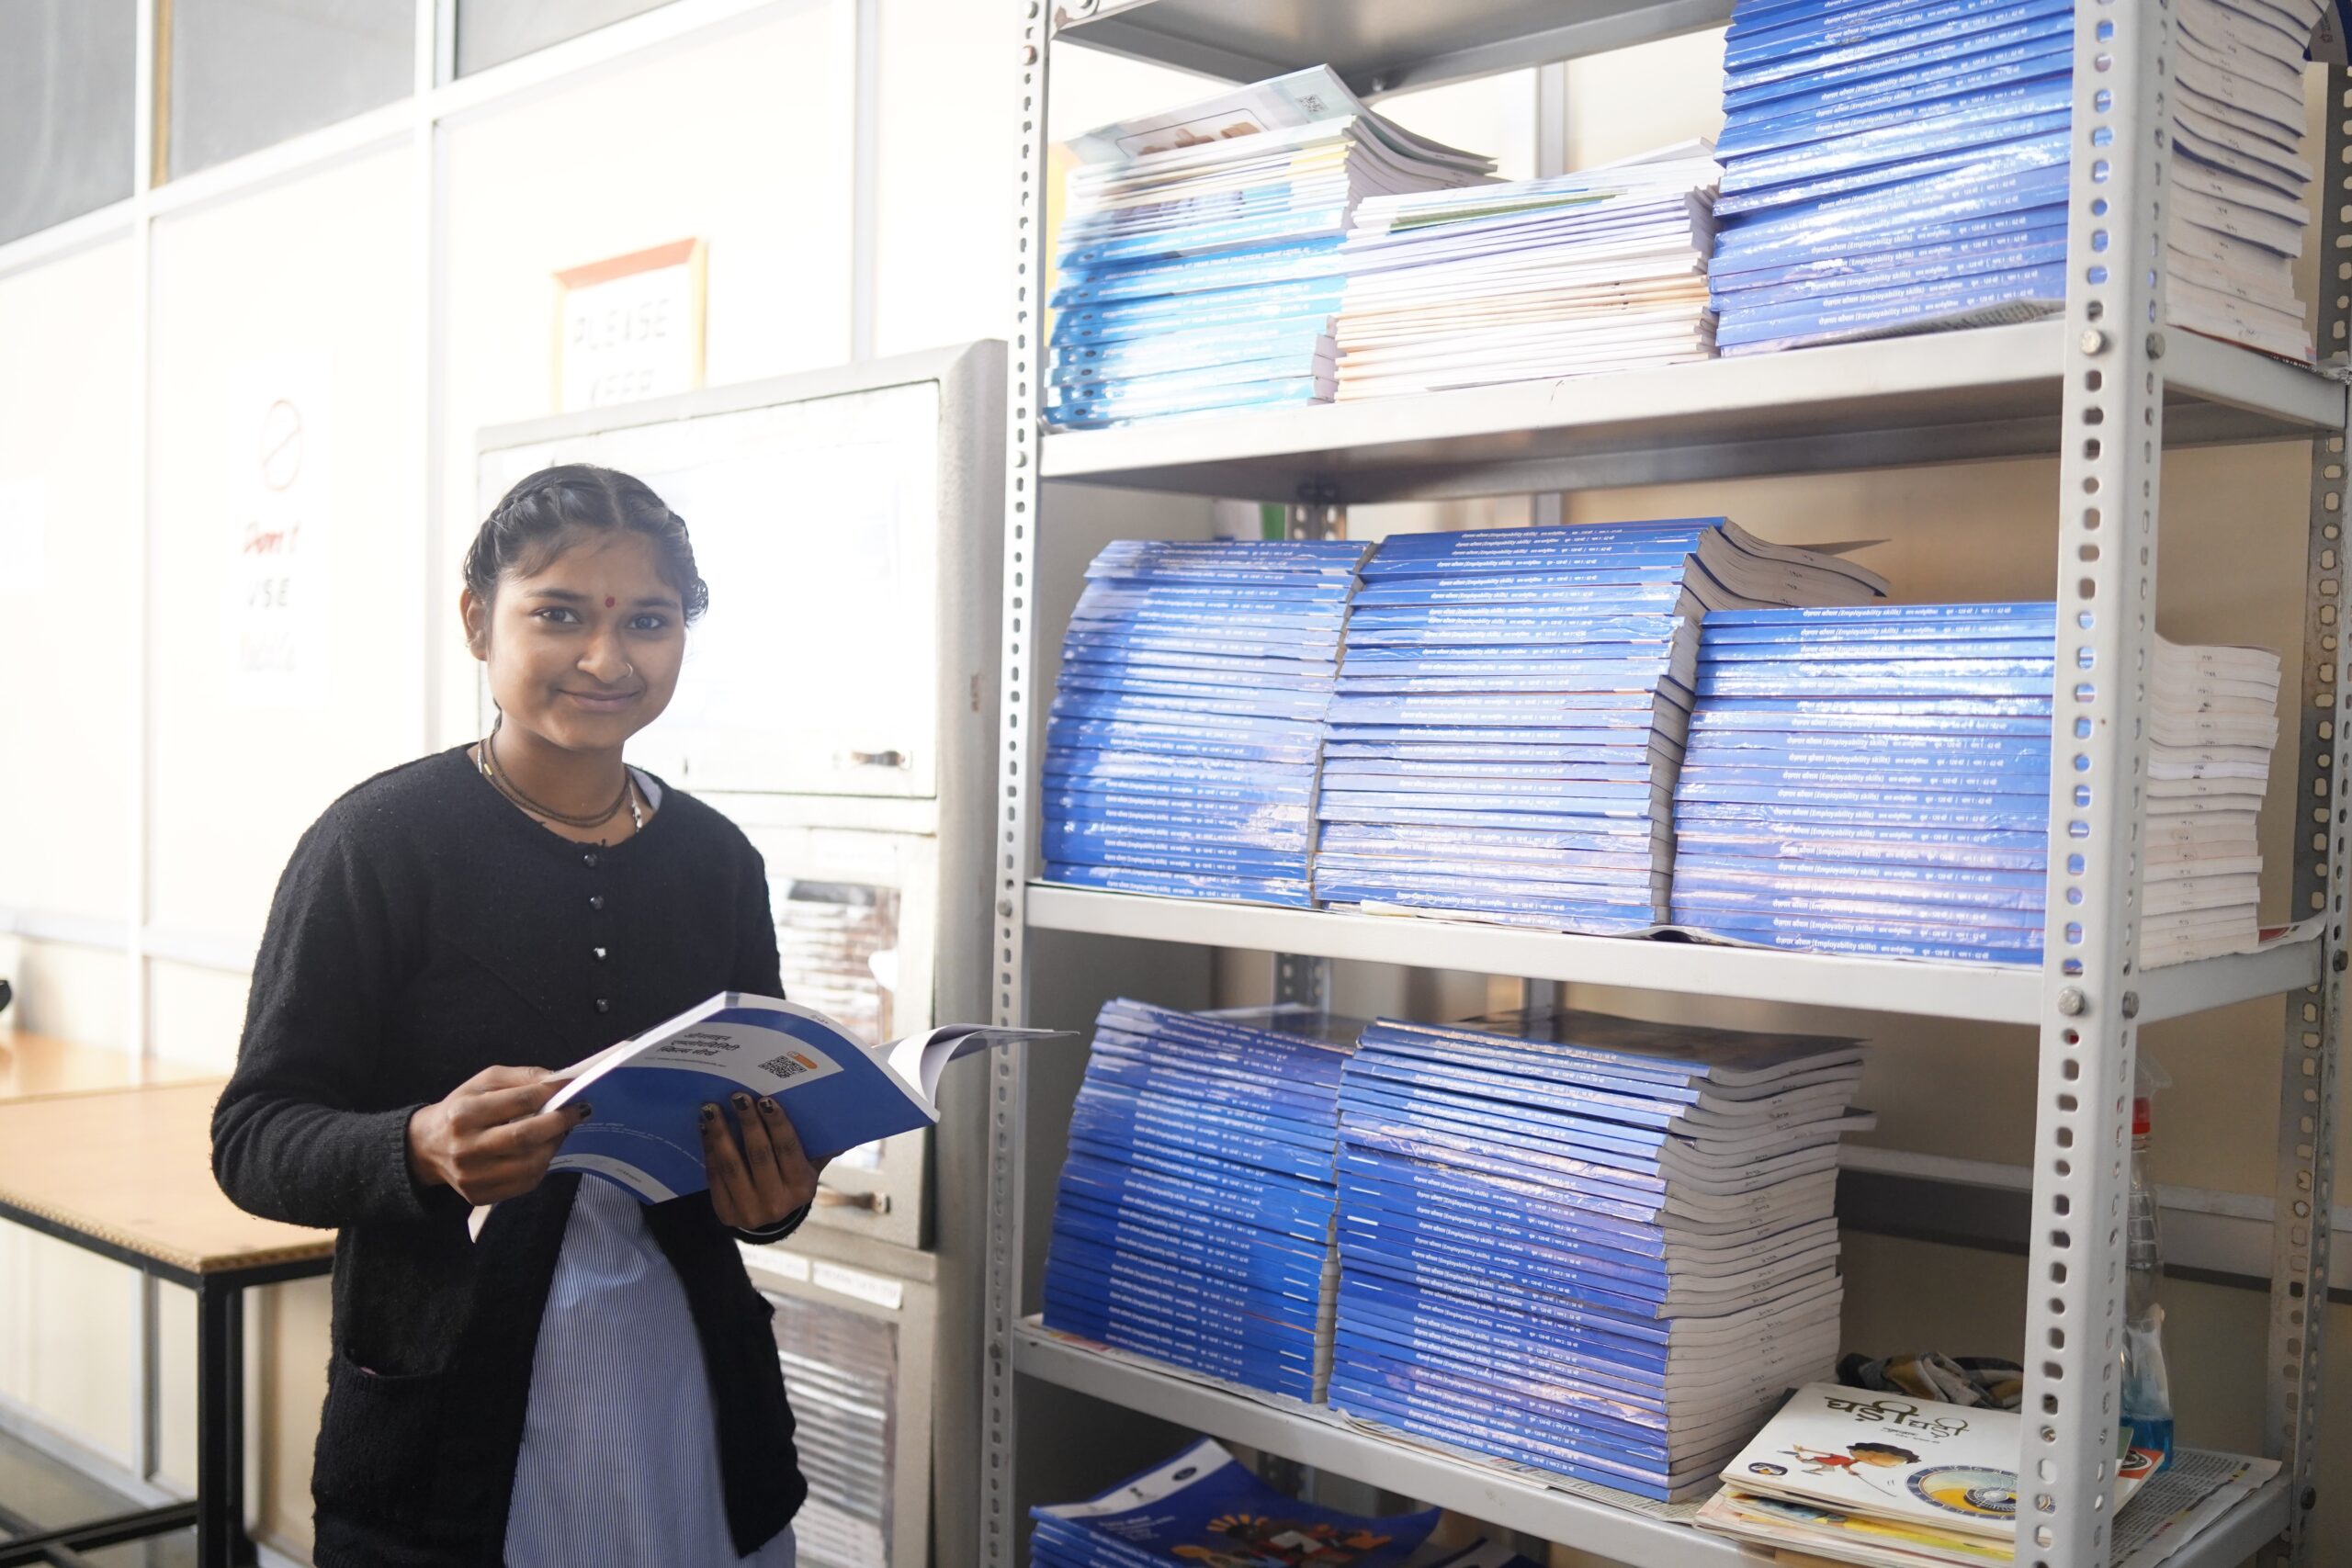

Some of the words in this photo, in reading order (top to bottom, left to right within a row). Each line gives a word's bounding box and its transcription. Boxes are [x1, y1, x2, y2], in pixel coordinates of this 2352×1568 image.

[1858, 2, 1900, 16] (Employability
[1860, 18, 1903, 32] (Employability
[1904, 14, 1922, 23] skills)
[1898, 33, 1916, 43] skills)
[1857, 57, 1900, 71] (Employability
[1901, 52, 1918, 62] skills)
[1855, 77, 1897, 92] (Employability
[1898, 73, 1917, 83] skills)
[1849, 96, 1893, 109] (Employability
[1894, 91, 1911, 100] skills)
[1850, 112, 1894, 125] (Employability
[1895, 108, 1913, 118] skills)
[1851, 187, 1893, 202] (Employability
[1848, 237, 1892, 249] (Employability
[1893, 234, 1912, 243] skills)
[1894, 251, 1914, 261] skills)
[1847, 273, 1891, 286] (Employability
[1892, 270, 1910, 280] skills)
[1860, 289, 1905, 301] (Employability
[1905, 287, 1924, 296] skills)
[1855, 308, 1900, 321] (Employability
[1901, 304, 1919, 314] skills)
[1823, 738, 1868, 747] (Employability
[1825, 754, 1870, 764] (Employability
[1871, 756, 1890, 764] skills)
[1819, 773, 1864, 782] (Employability
[1814, 791, 1859, 800] (Employability
[1860, 793, 1879, 801] skills)
[1809, 809, 1854, 818] (Employability
[1810, 828, 1855, 837] (Employability
[1856, 829, 1874, 838] skills)
[1815, 864, 1859, 875] (Employability
[1860, 867, 1879, 876] skills)
[1809, 920, 1854, 931] (Employability
[1855, 924, 1873, 933] skills)
[1812, 939, 1856, 950] (Employability
[1857, 942, 1876, 951] skills)
[1824, 1395, 1919, 1425] घड़ी
[1908, 1416, 1970, 1439] घड़ी
